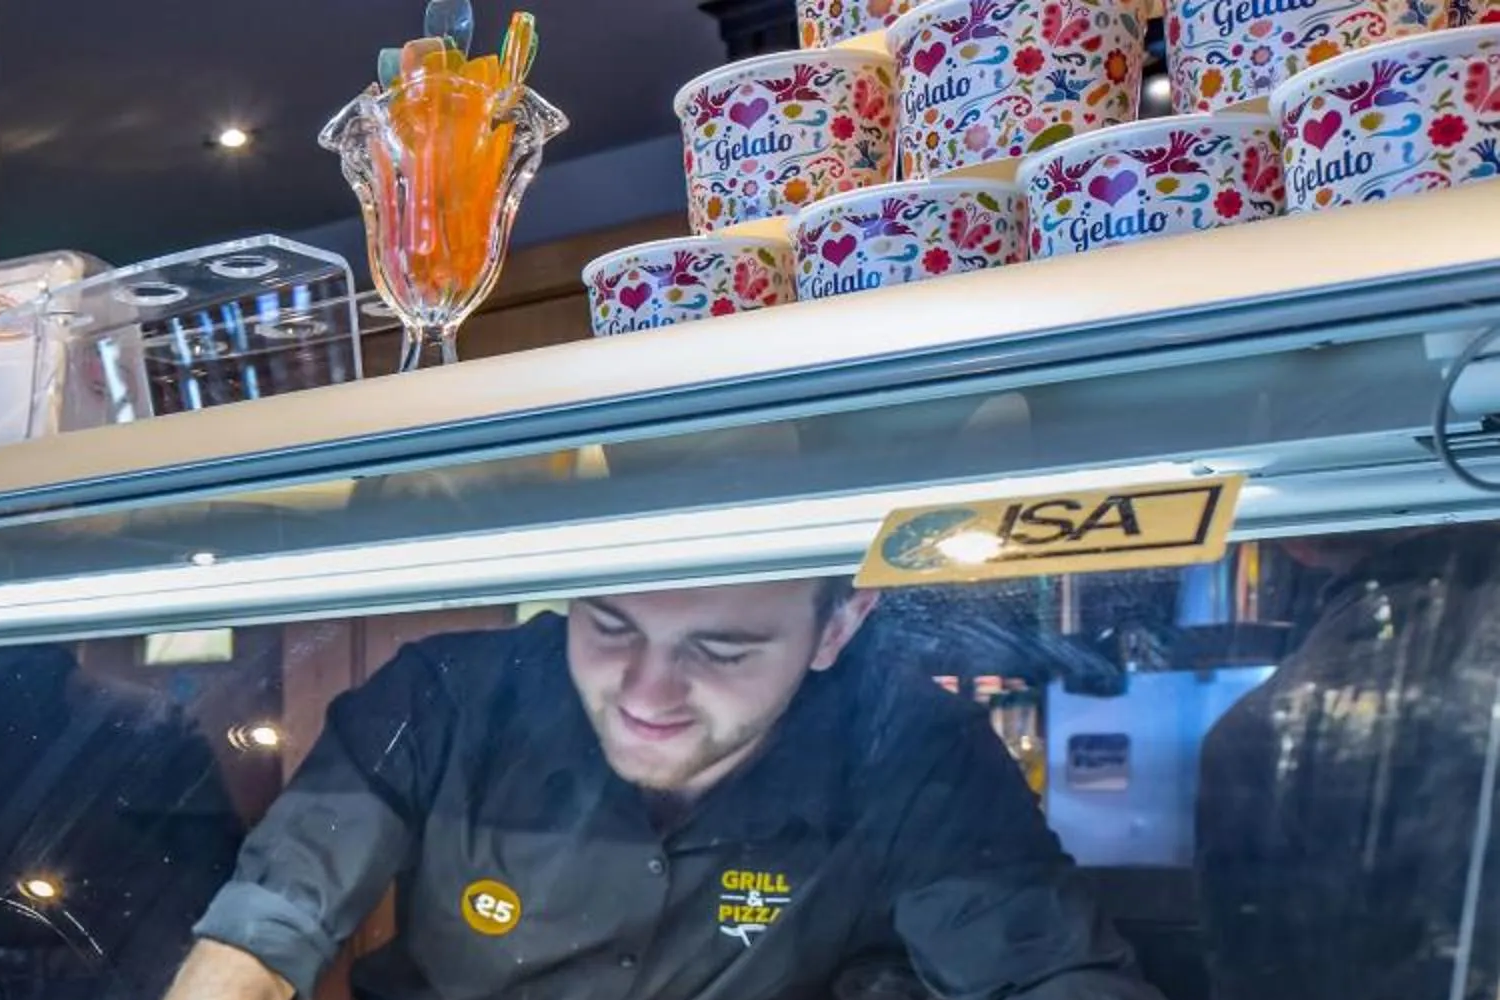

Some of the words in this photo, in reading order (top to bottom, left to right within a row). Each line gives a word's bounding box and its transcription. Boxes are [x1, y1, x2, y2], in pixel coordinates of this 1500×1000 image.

[905, 75, 971, 120] Gelato
[715, 131, 793, 170] Gelato
[1293, 150, 1375, 202] Gelato
[1069, 208, 1169, 252] Gelato
[997, 495, 1141, 547] ISA
[722, 869, 791, 893] GRILL
[746, 889, 764, 907] &
